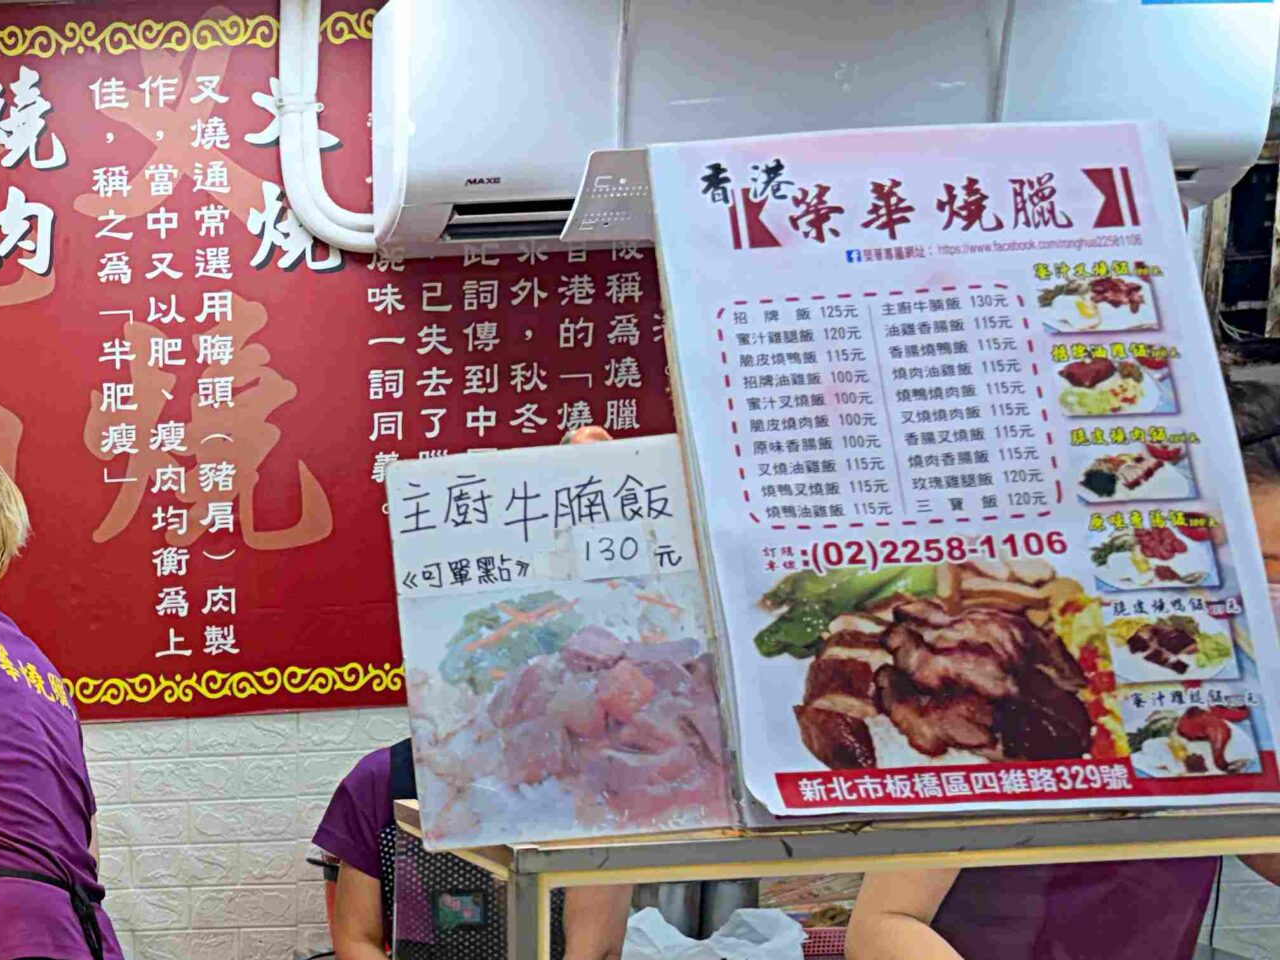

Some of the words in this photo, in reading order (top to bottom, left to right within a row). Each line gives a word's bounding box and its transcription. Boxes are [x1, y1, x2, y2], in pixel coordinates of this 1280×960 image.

[464, 177, 501, 186] MAXE
[700, 158, 796, 206] 香港
[971, 294, 1009, 308] 130元
[821, 304, 859, 319] 125元
[974, 316, 1013, 330] 115元
[824, 326, 862, 341] 120元
[978, 338, 1017, 351] 115元
[826, 348, 866, 363] 115元
[982, 359, 1022, 374] 115元
[831, 370, 870, 384] 100元
[986, 381, 1026, 395] 115元
[834, 391, 873, 405] 100元
[990, 403, 1030, 417] 115元
[839, 413, 877, 427] 100元
[995, 425, 1035, 439] 115元
[843, 434, 881, 449] 100元
[998, 447, 1039, 461] 115元
[846, 457, 885, 471] 115元
[1003, 469, 1043, 483] 120元
[850, 479, 889, 493] 115元
[1008, 491, 1048, 506] 120元
[400, 474, 673, 542] 主廚牛腩飯
[853, 502, 893, 516] 115元
[584, 536, 639, 562] 130
[799, 764, 1133, 803] 新北市板橋區四維路329號
